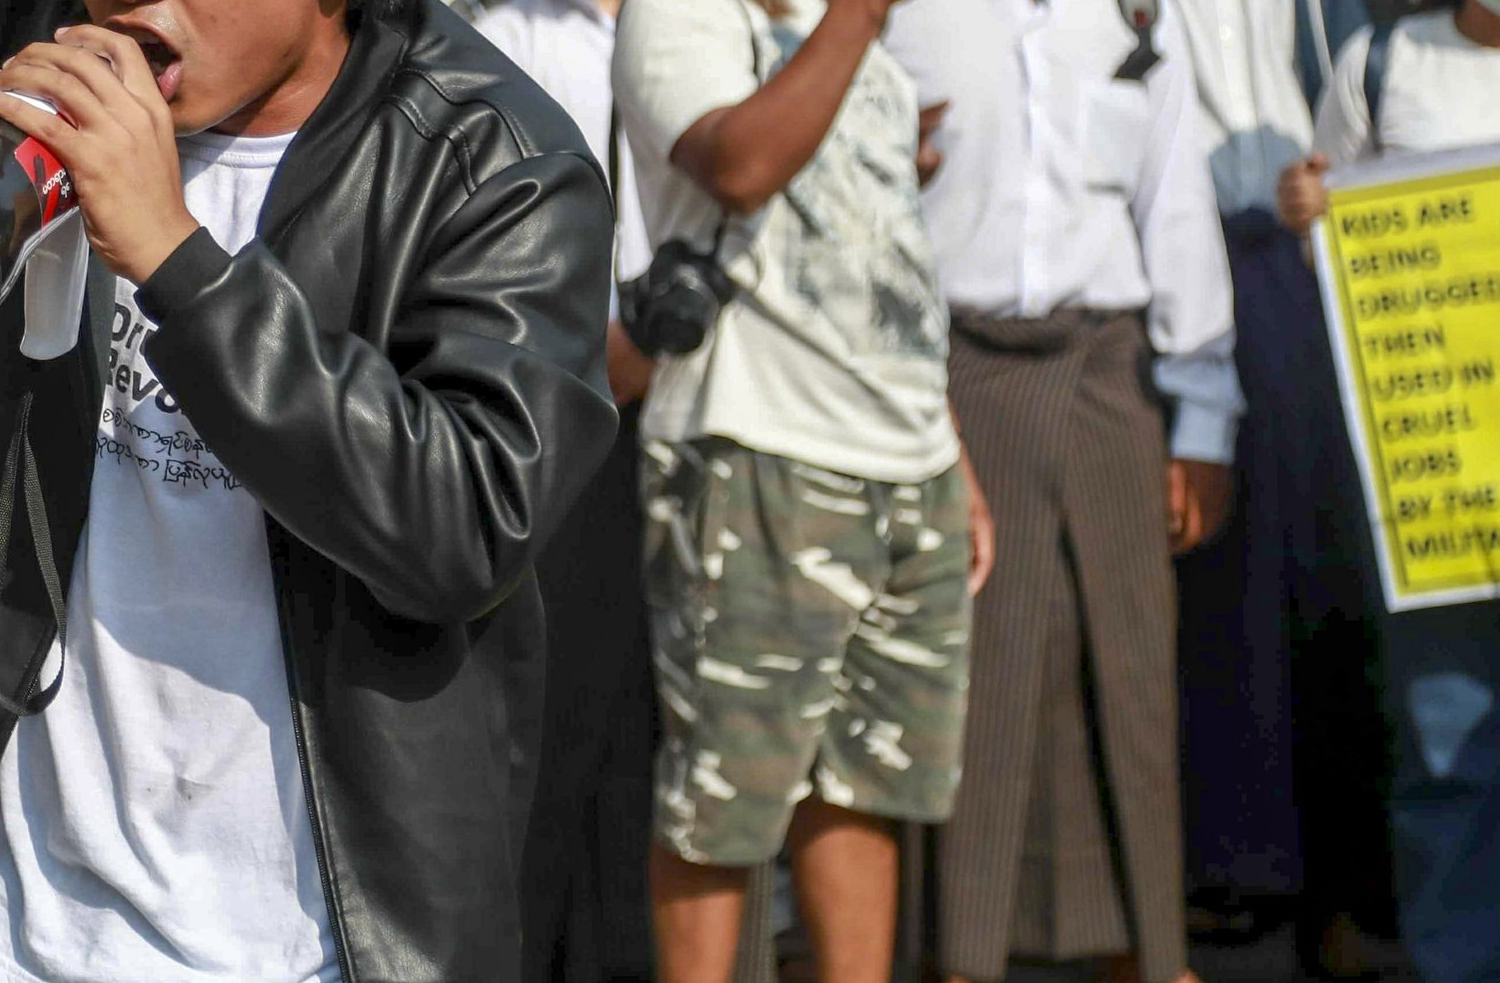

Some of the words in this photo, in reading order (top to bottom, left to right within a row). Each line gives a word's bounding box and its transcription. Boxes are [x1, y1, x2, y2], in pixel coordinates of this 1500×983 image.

[1342, 208, 1407, 236] KIDS
[1417, 196, 1474, 226] ARE
[1350, 246, 1440, 275] BEING
[1364, 326, 1446, 354] THEN
[1373, 370, 1453, 400] USED
[1462, 360, 1495, 386] IN
[1382, 404, 1476, 439] CRUEL
[1392, 448, 1462, 480] JOBS
[1398, 494, 1433, 521] BY
[1444, 483, 1496, 512] THE
